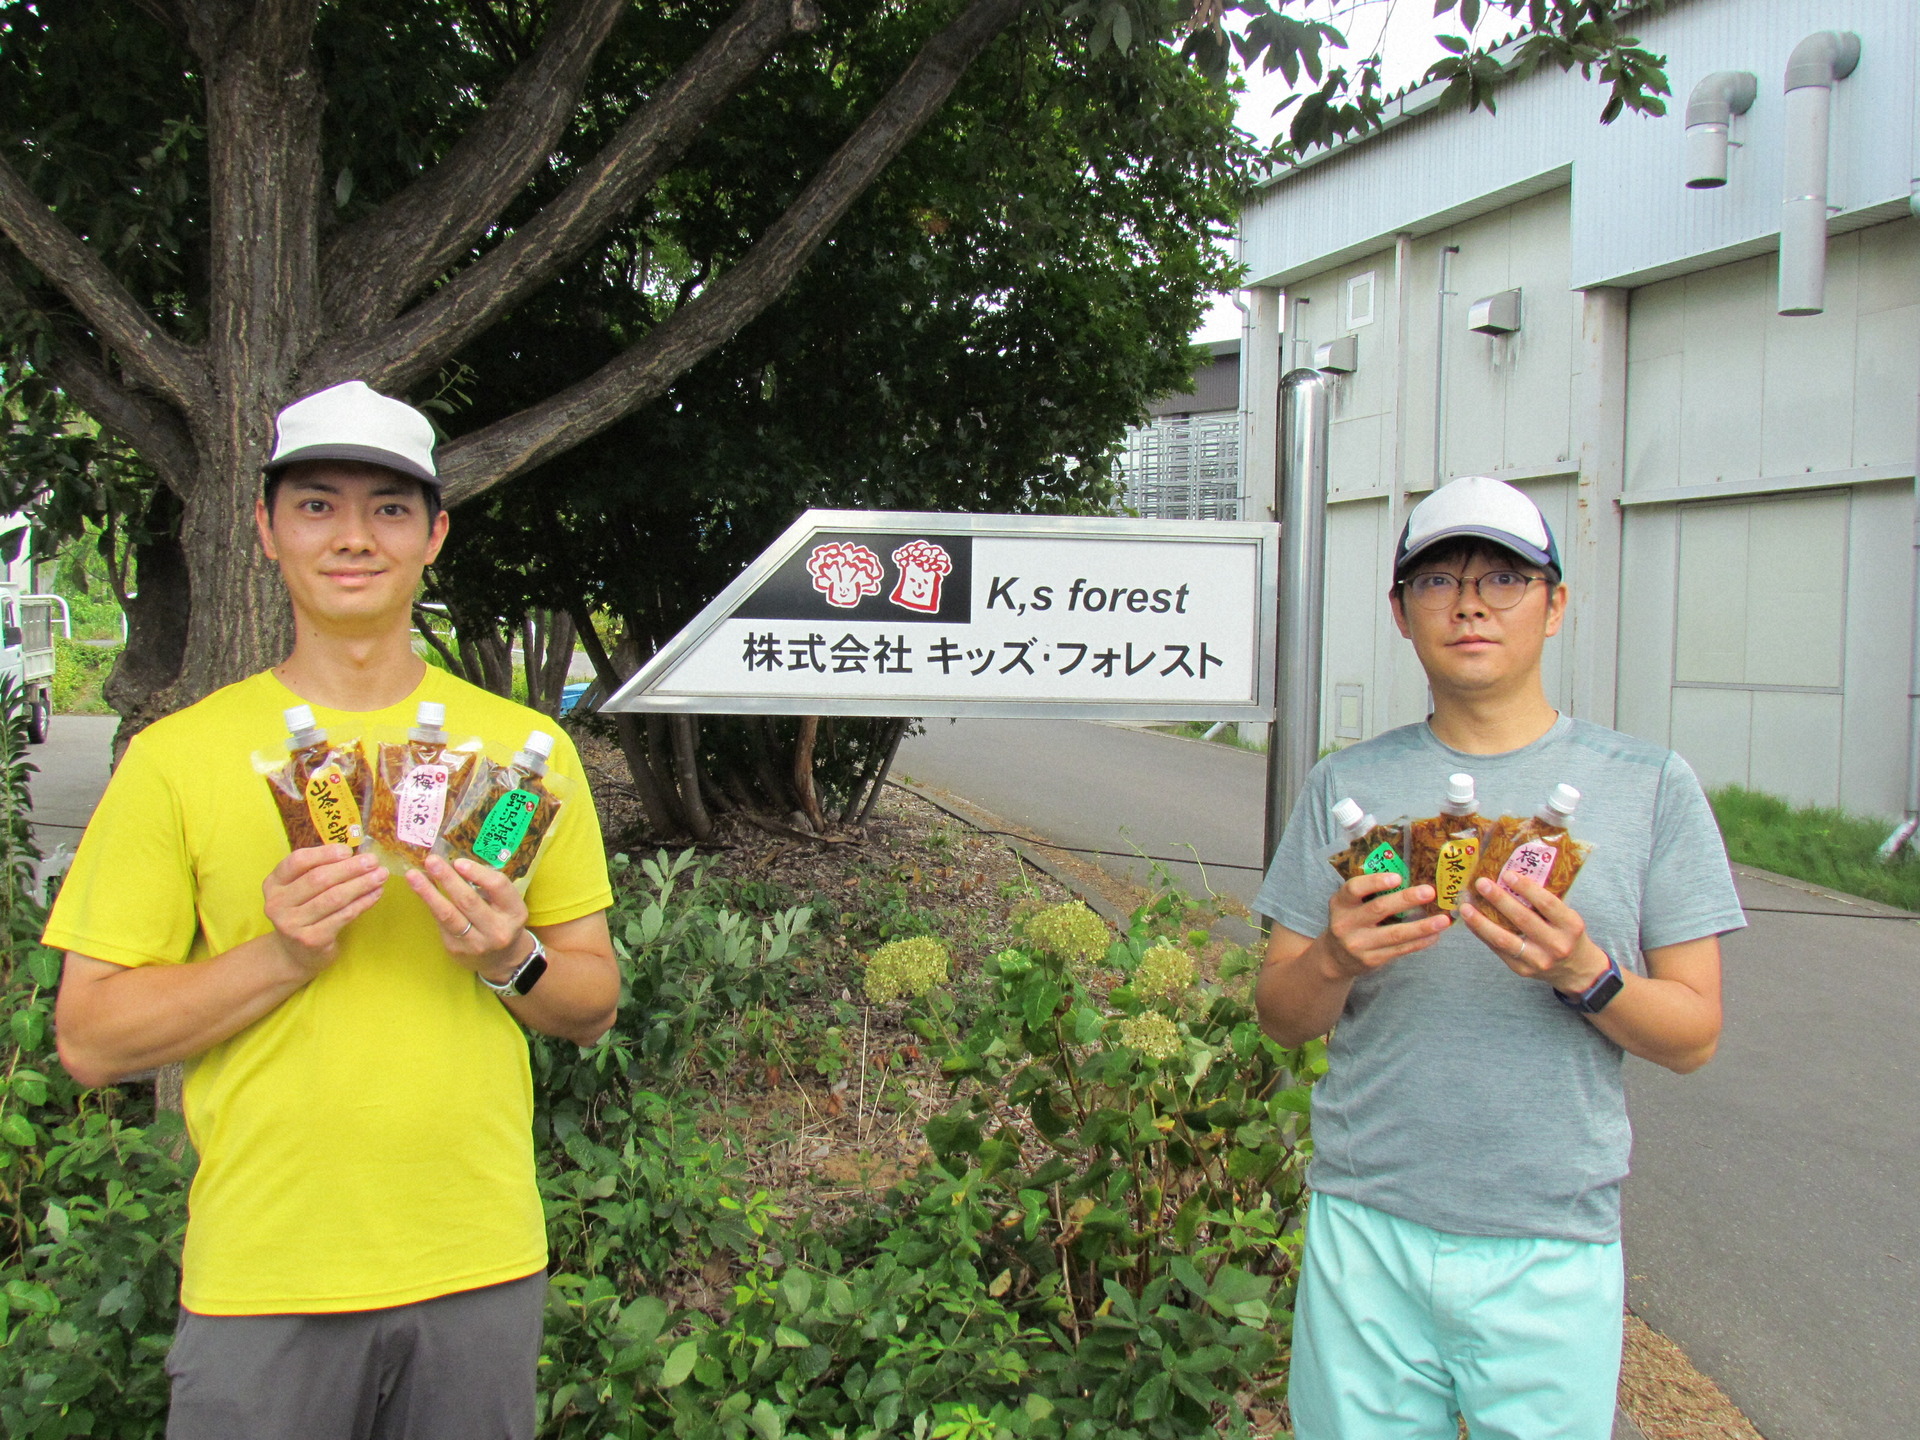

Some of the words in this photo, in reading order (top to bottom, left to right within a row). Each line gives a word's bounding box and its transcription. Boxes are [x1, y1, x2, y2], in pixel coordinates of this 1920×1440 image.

[987, 576, 1054, 616] K,s
[1068, 578, 1190, 614] forest
[742, 632, 913, 674] 株式会社
[927, 636, 1223, 679] キッズ・フォレスト
[411, 771, 435, 825] 梅かつお
[494, 793, 527, 846] 野沢菜
